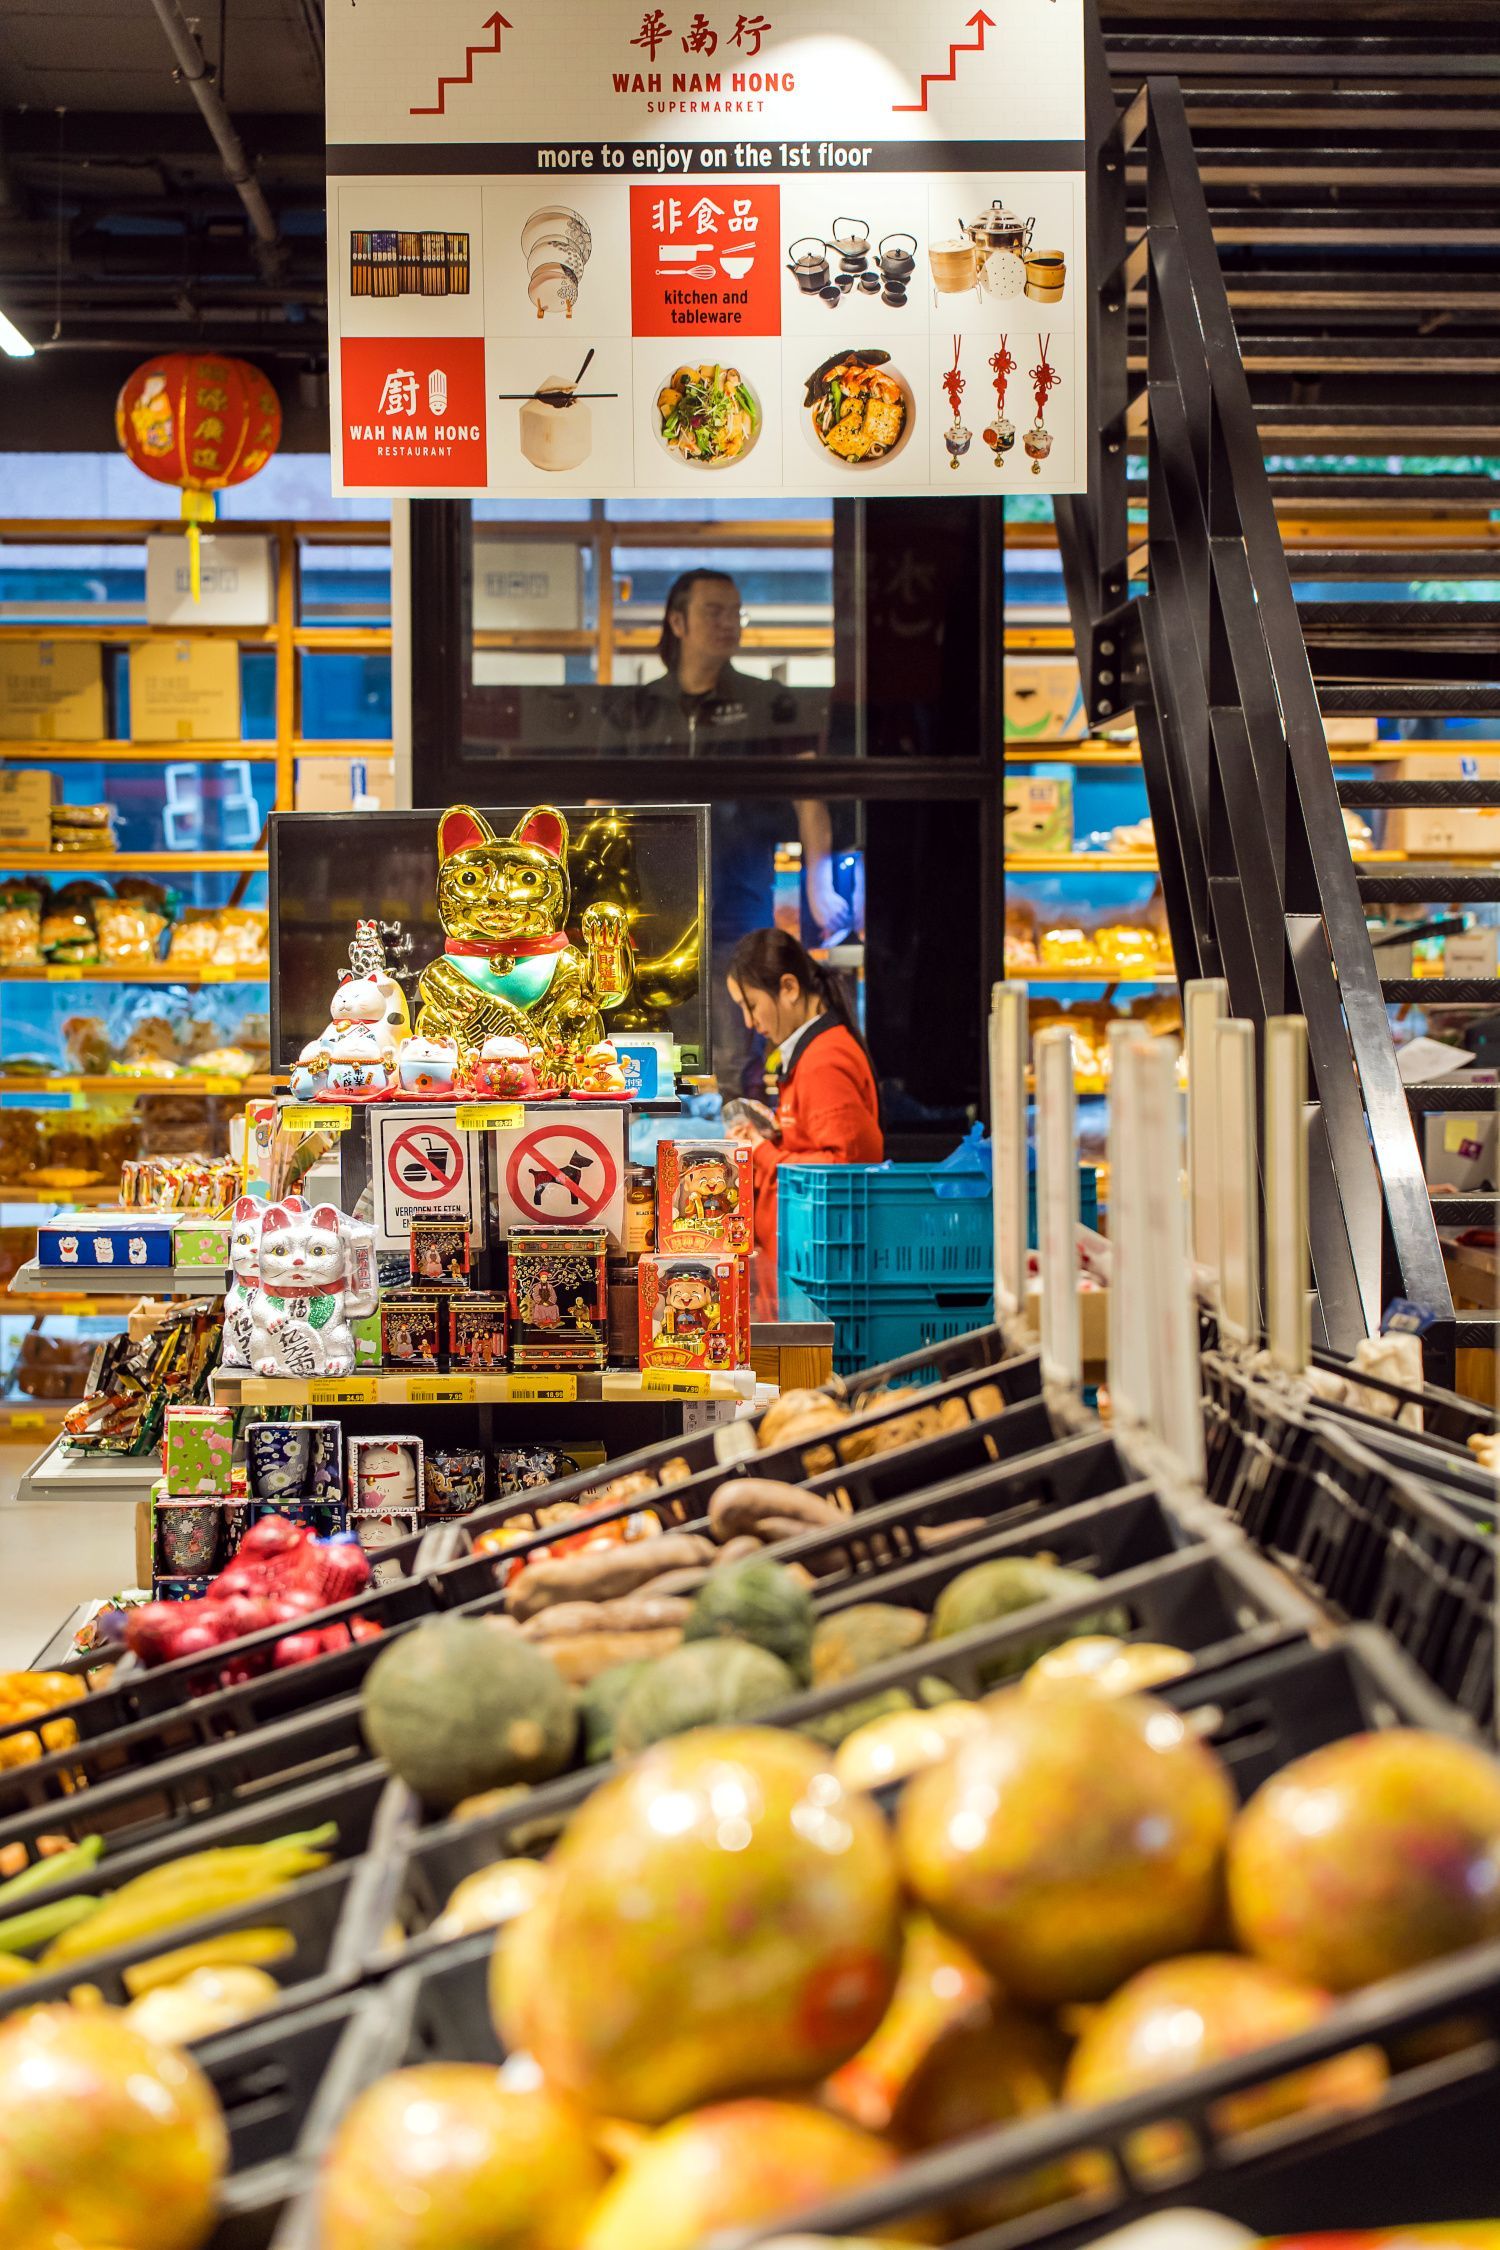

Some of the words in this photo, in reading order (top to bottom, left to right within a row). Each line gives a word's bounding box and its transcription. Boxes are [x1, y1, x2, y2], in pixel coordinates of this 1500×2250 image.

[629, 9, 772, 62] 華南行
[612, 73, 662, 93] WAH
[672, 73, 721, 92] NAM
[732, 72, 795, 92] HONG
[647, 101, 765, 113] SUPERMARKET
[537, 147, 593, 168] more
[601, 144, 625, 168] to
[632, 143, 692, 173] enjoy
[699, 147, 727, 167] on
[734, 143, 772, 167] the
[779, 143, 811, 167] 1st
[818, 142, 873, 167] floor
[651, 197, 759, 235] 非食品
[664, 290, 718, 305] kitchen
[722, 290, 748, 304] and
[671, 309, 742, 324] tableware
[378, 368, 420, 416] 廚
[349, 425, 385, 440] WAH
[392, 425, 427, 440] NAM
[434, 425, 480, 440] HONG
[377, 446, 452, 456] RESTAURANT
